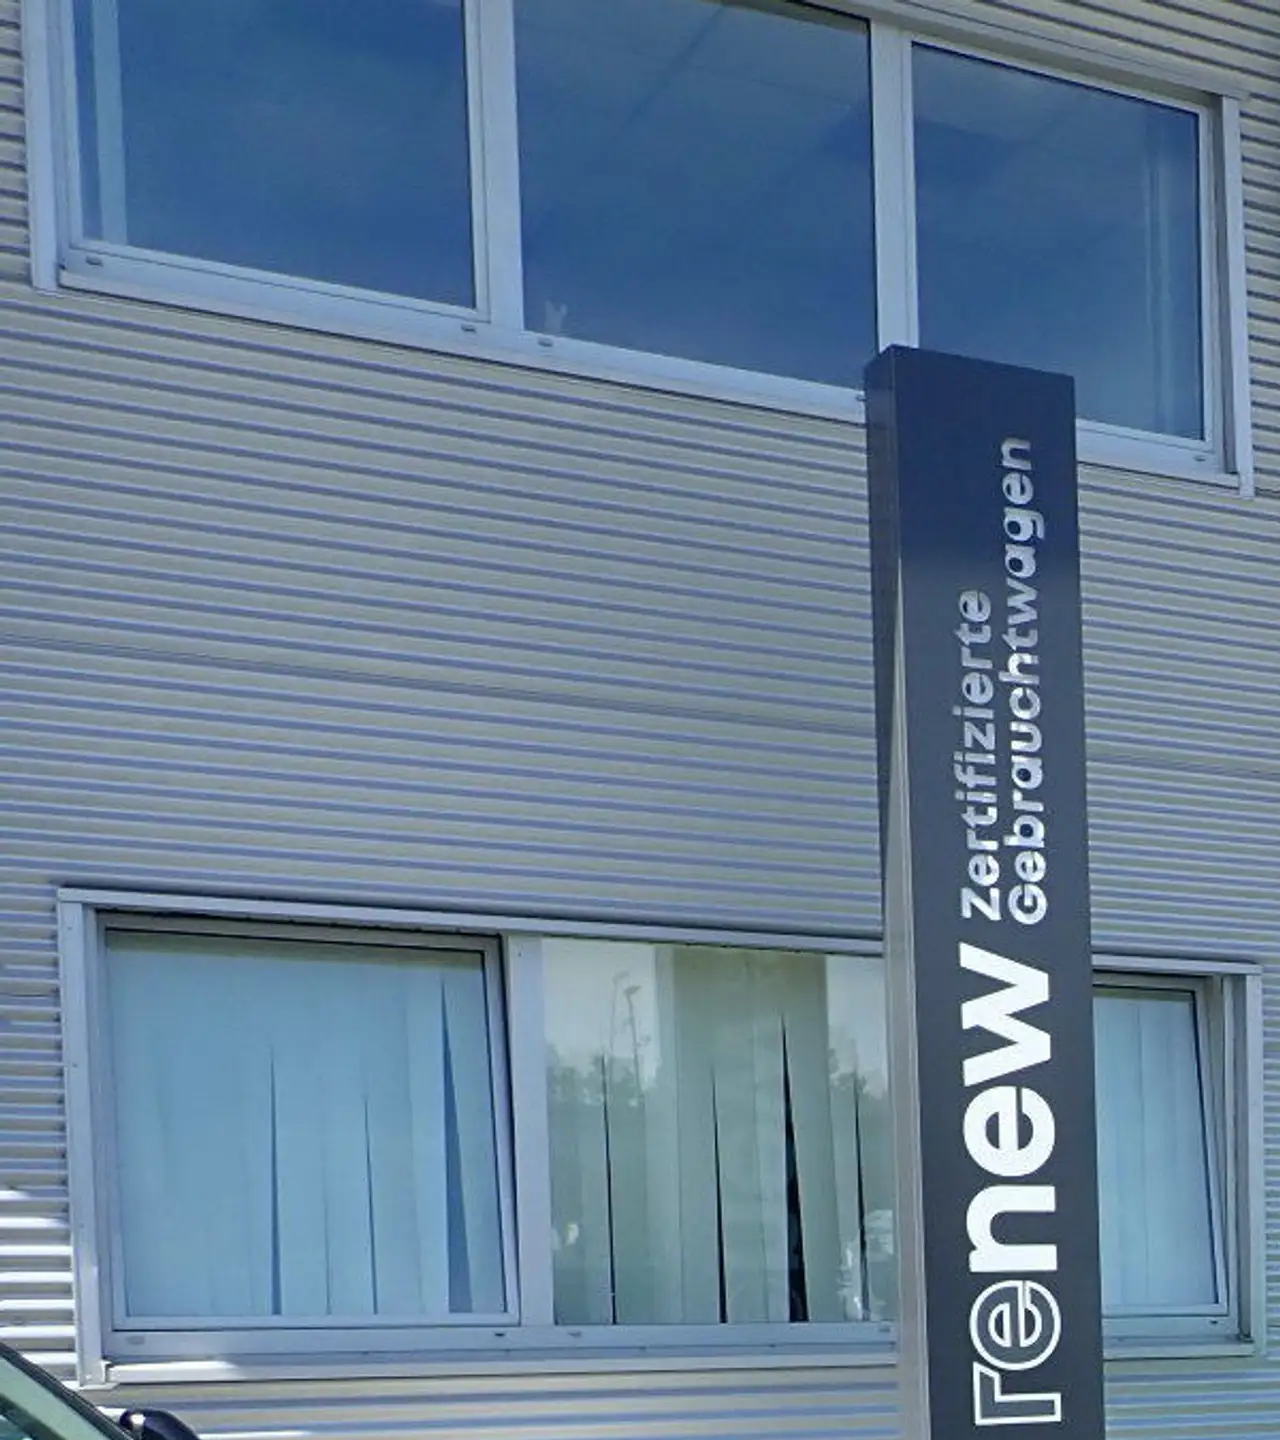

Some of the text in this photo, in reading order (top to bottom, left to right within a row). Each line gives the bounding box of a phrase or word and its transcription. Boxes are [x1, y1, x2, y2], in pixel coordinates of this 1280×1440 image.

[952, 589, 1002, 922] Zertifizierte
[998, 437, 1048, 925] Gebrauchtwagen
[958, 942, 1062, 1426] renew
